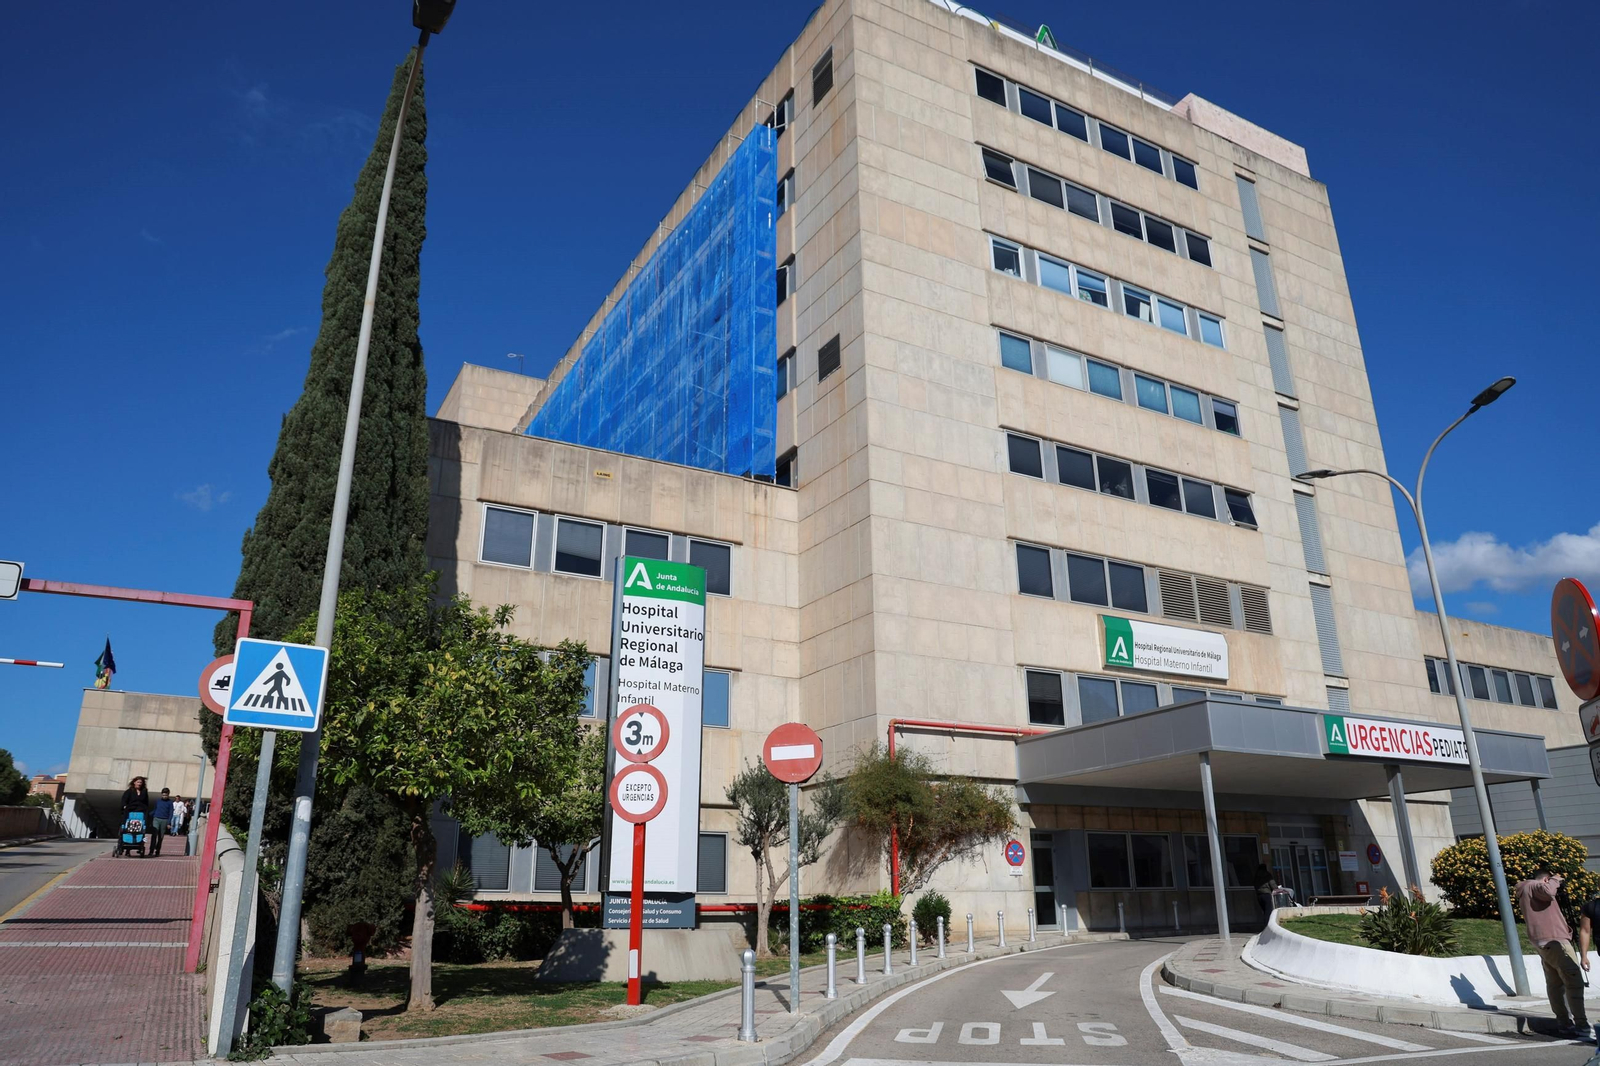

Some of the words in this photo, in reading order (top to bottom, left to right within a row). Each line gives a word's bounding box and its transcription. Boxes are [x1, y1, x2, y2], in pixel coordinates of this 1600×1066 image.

[656, 572, 678, 581] Junta
[622, 602, 678, 618] Hospital
[621, 620, 704, 642] Universitario
[620, 638, 678, 654] Regional
[1135, 642, 1153, 652] Hospital
[1154, 644, 1173, 654] Regional
[1174, 647, 1200, 658] Universitario
[1206, 650, 1222, 662] Málaga
[620, 655, 636, 666] de
[639, 656, 684, 673] Málaga
[1134, 655, 1162, 667] Hospital
[1164, 658, 1190, 670] Materno
[1190, 662, 1213, 673] Infantil
[618, 678, 660, 690] Hospital
[664, 682, 700, 695] Materno
[618, 694, 654, 705] Infantil
[1346, 723, 1433, 756] URGENCIAS
[1432, 738, 1468, 760] PEDIATR
[626, 784, 652, 792] EXCEPTO
[622, 794, 654, 802] URGENCIAS
[894, 1022, 1128, 1046] STOP
